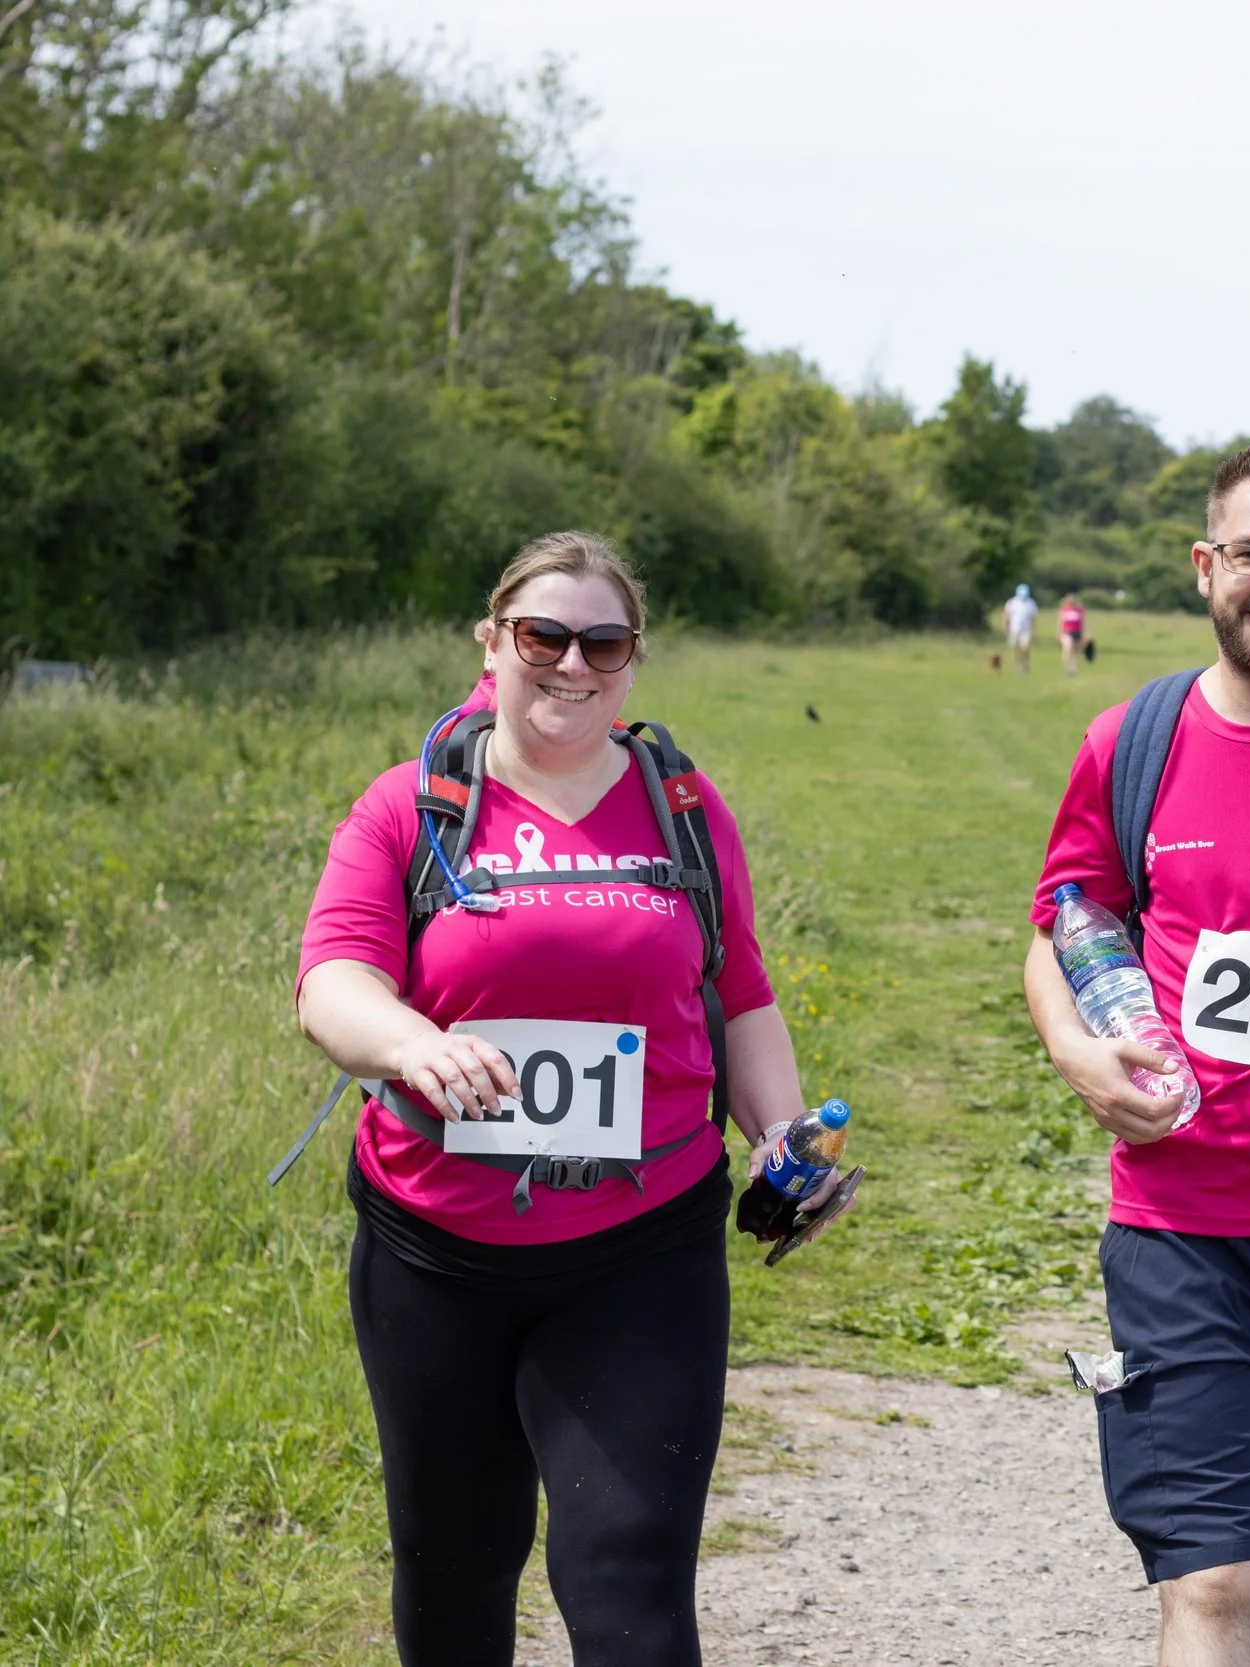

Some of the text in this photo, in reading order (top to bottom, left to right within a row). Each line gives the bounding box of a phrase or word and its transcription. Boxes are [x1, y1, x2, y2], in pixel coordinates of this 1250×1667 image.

[1177, 841, 1197, 850] Walk
[1197, 840, 1215, 848] Ever
[564, 889, 678, 918] cancer
